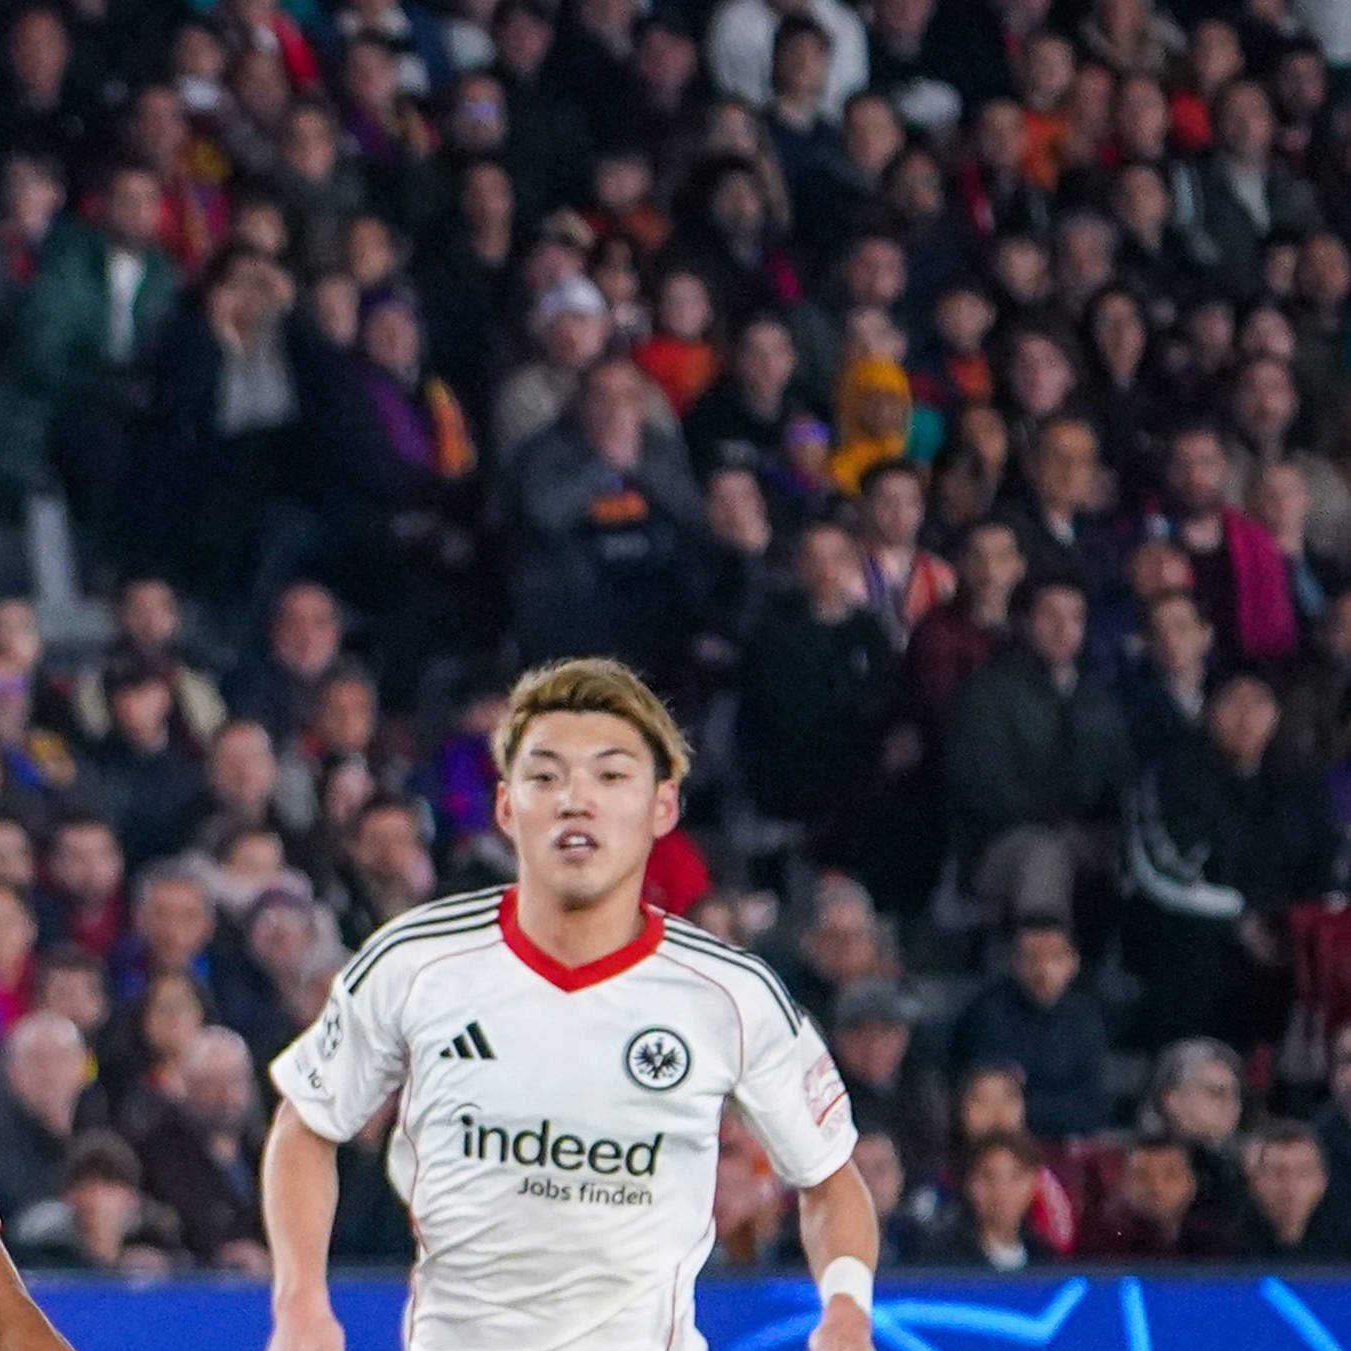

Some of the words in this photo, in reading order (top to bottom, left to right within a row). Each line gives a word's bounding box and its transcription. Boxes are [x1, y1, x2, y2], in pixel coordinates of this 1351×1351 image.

[459, 1108, 664, 1178] indeed
[517, 1177, 571, 1201] Jobs
[578, 1183, 653, 1206] finden
